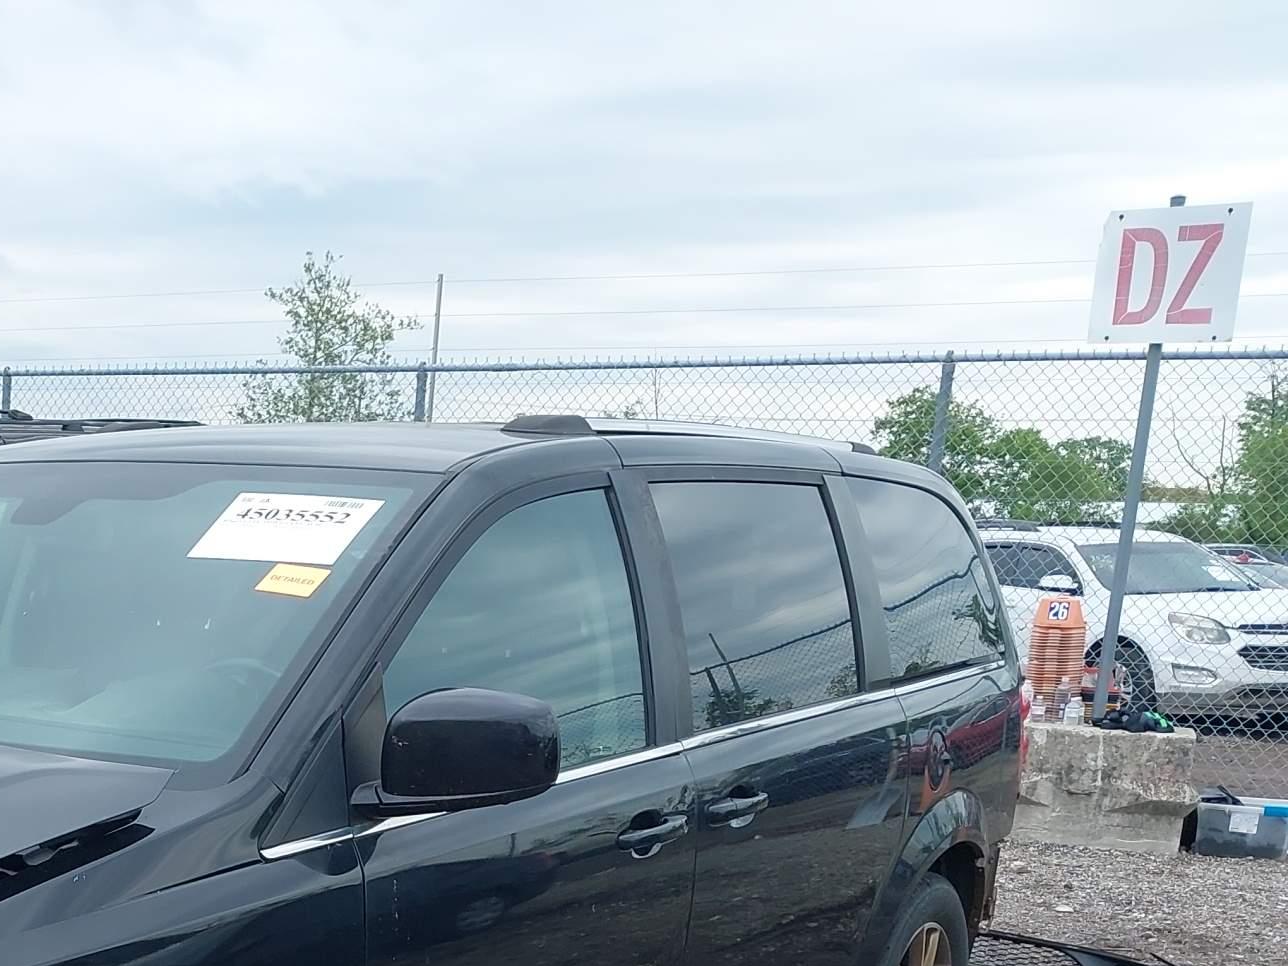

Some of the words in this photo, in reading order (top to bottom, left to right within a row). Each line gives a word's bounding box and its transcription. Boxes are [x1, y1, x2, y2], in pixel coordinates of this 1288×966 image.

[1112, 223, 1225, 326] DZ
[236, 507, 352, 525] 45035552
[1049, 602, 1070, 621] 26
